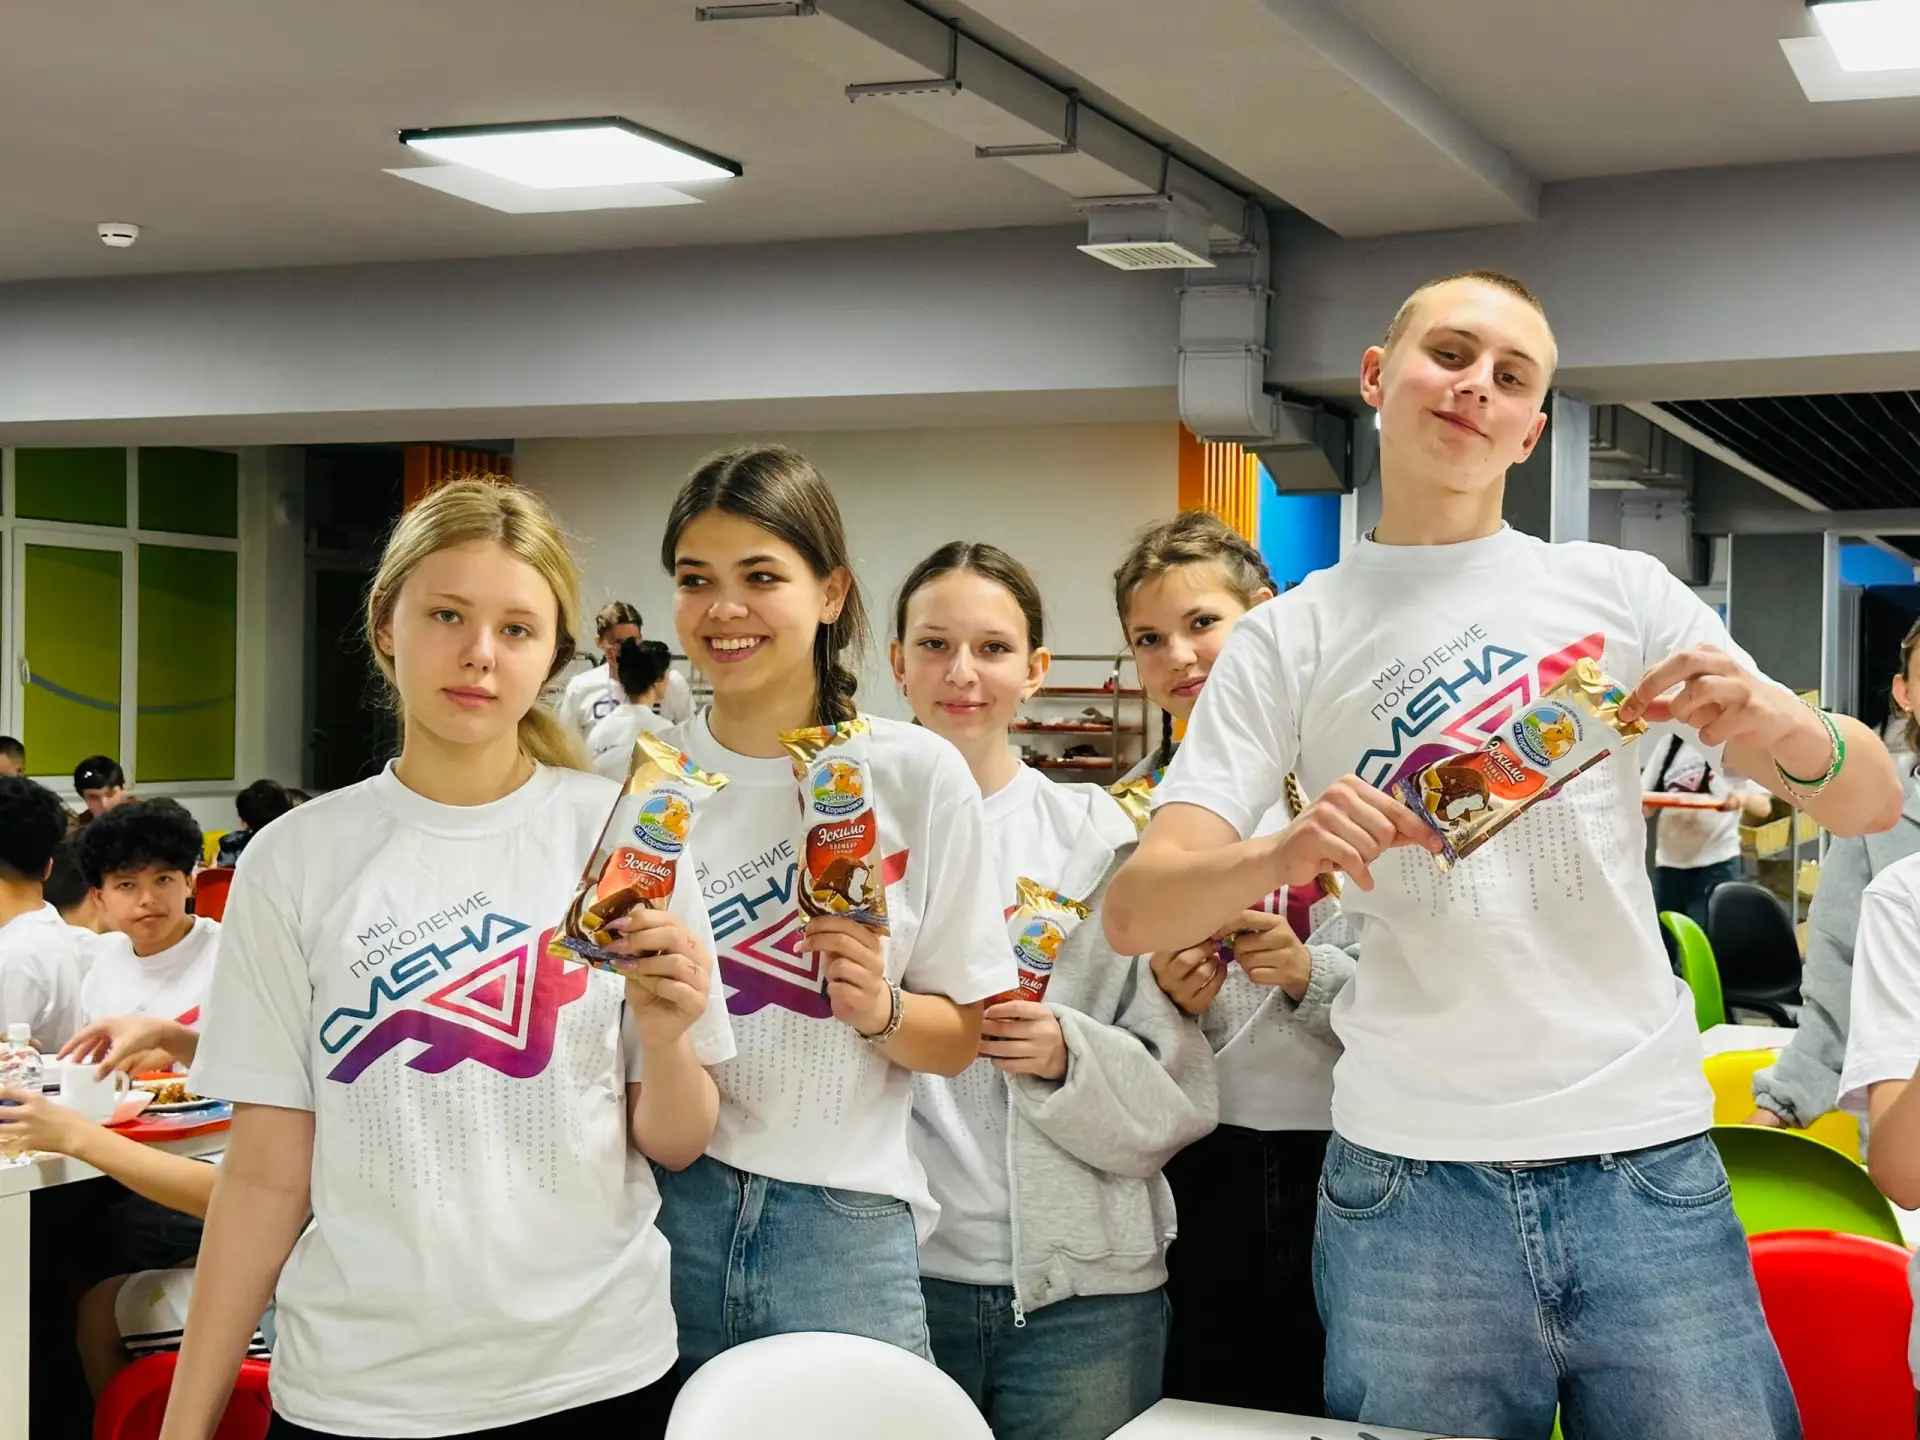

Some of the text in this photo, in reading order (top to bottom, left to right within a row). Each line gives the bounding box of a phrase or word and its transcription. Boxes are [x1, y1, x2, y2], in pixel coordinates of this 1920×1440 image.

[1371, 623, 1488, 721] ПОКОЛЕНИЕ
[1372, 658, 1406, 690] МЫ
[1524, 724, 1551, 755] КОРОВКА
[1486, 739, 1527, 783] Эскимо
[817, 824, 866, 847] Эскимо
[619, 852, 672, 877] Эскимо
[696, 861, 710, 880] Ы
[703, 840, 795, 899] КОЛЕНИЕ
[350, 890, 492, 979] ПОКОЛЕНИЕ
[357, 916, 398, 946] МЫ
[320, 913, 532, 1053] СМЕНА
